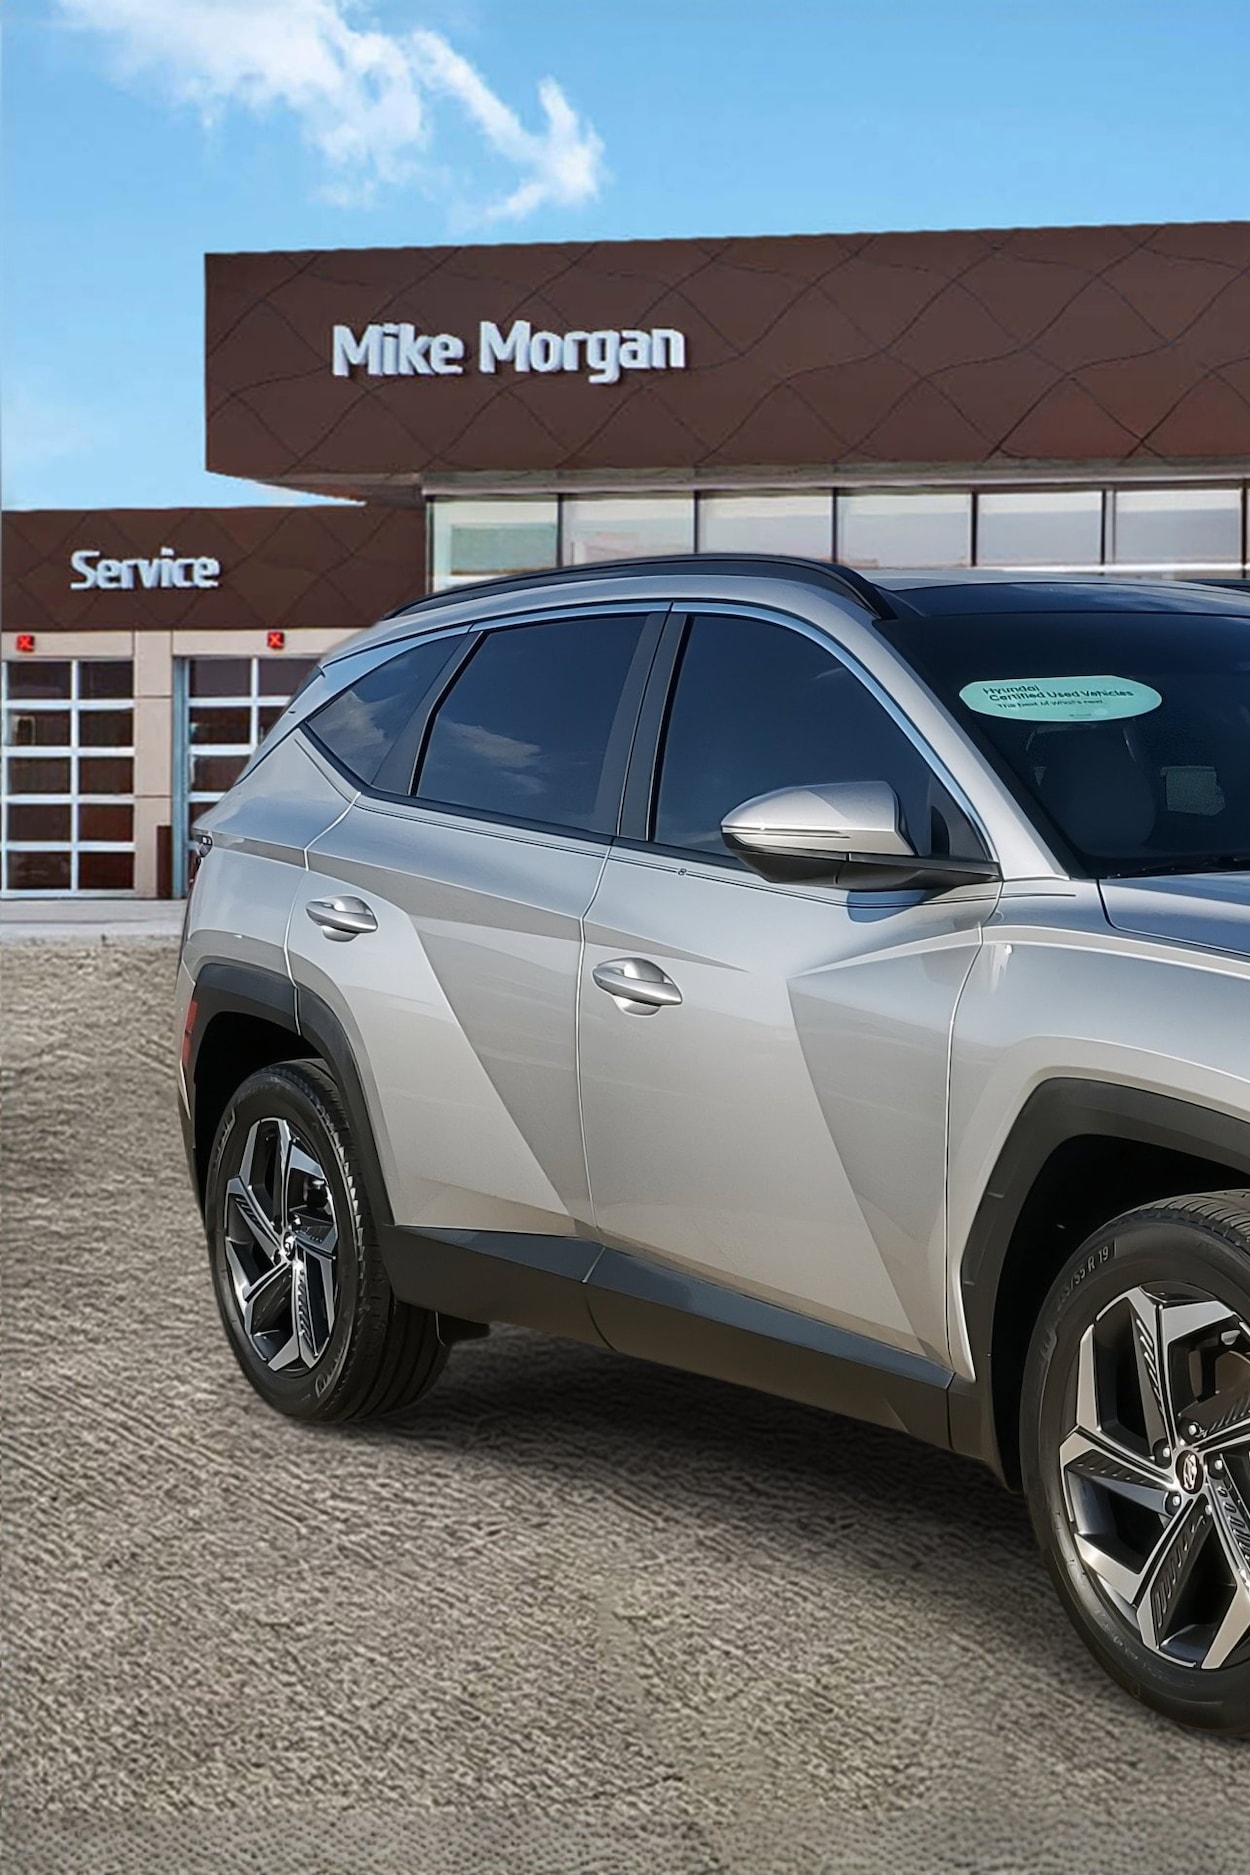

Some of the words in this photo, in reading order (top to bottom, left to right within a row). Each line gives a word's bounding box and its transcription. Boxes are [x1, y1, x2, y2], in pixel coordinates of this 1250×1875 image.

[332, 322, 465, 377] Mike
[479, 319, 686, 384] Morgan
[70, 546, 221, 591] Service
[983, 685, 1039, 694] Hyundai
[988, 691, 1046, 702] Certified
[1046, 690, 1083, 699] Used
[1082, 689, 1135, 699] Vehicles
[1087, 1256, 1096, 1272] R
[1098, 1246, 1109, 1264] 19
